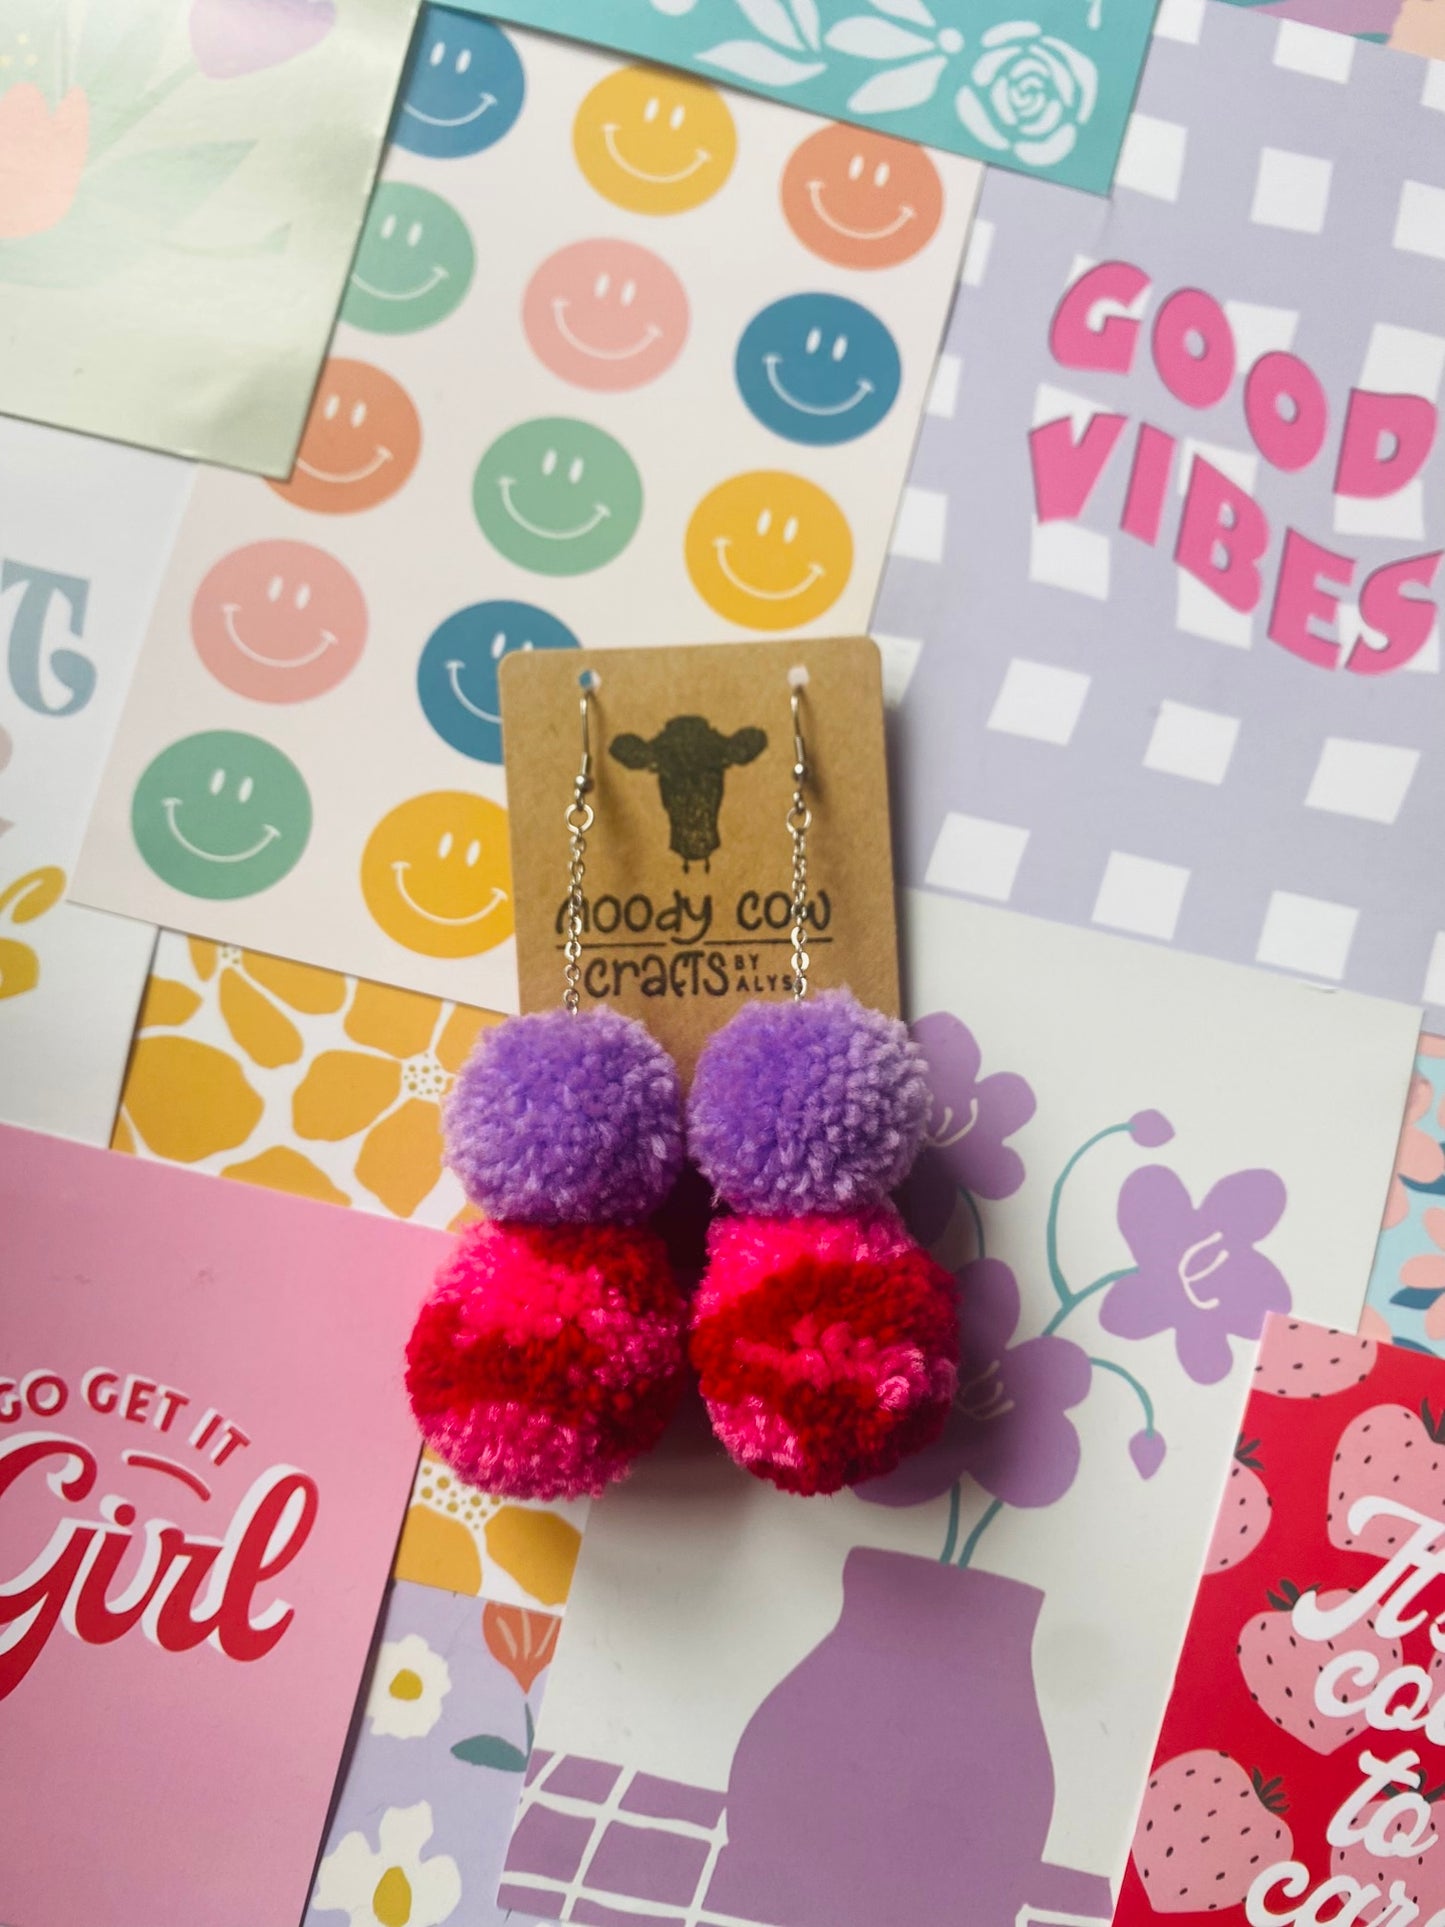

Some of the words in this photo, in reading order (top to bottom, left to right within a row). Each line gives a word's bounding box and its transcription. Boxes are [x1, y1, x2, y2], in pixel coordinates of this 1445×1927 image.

[1048, 259, 1437, 500] GOOD
[1028, 412, 1445, 676] VIBES
[735, 955, 759, 970] BY
[81, 1366, 190, 1432] GET
[188, 1408, 251, 1466] IT
[1326, 1750, 1439, 1858] to
[1245, 1861, 1445, 1927] car
